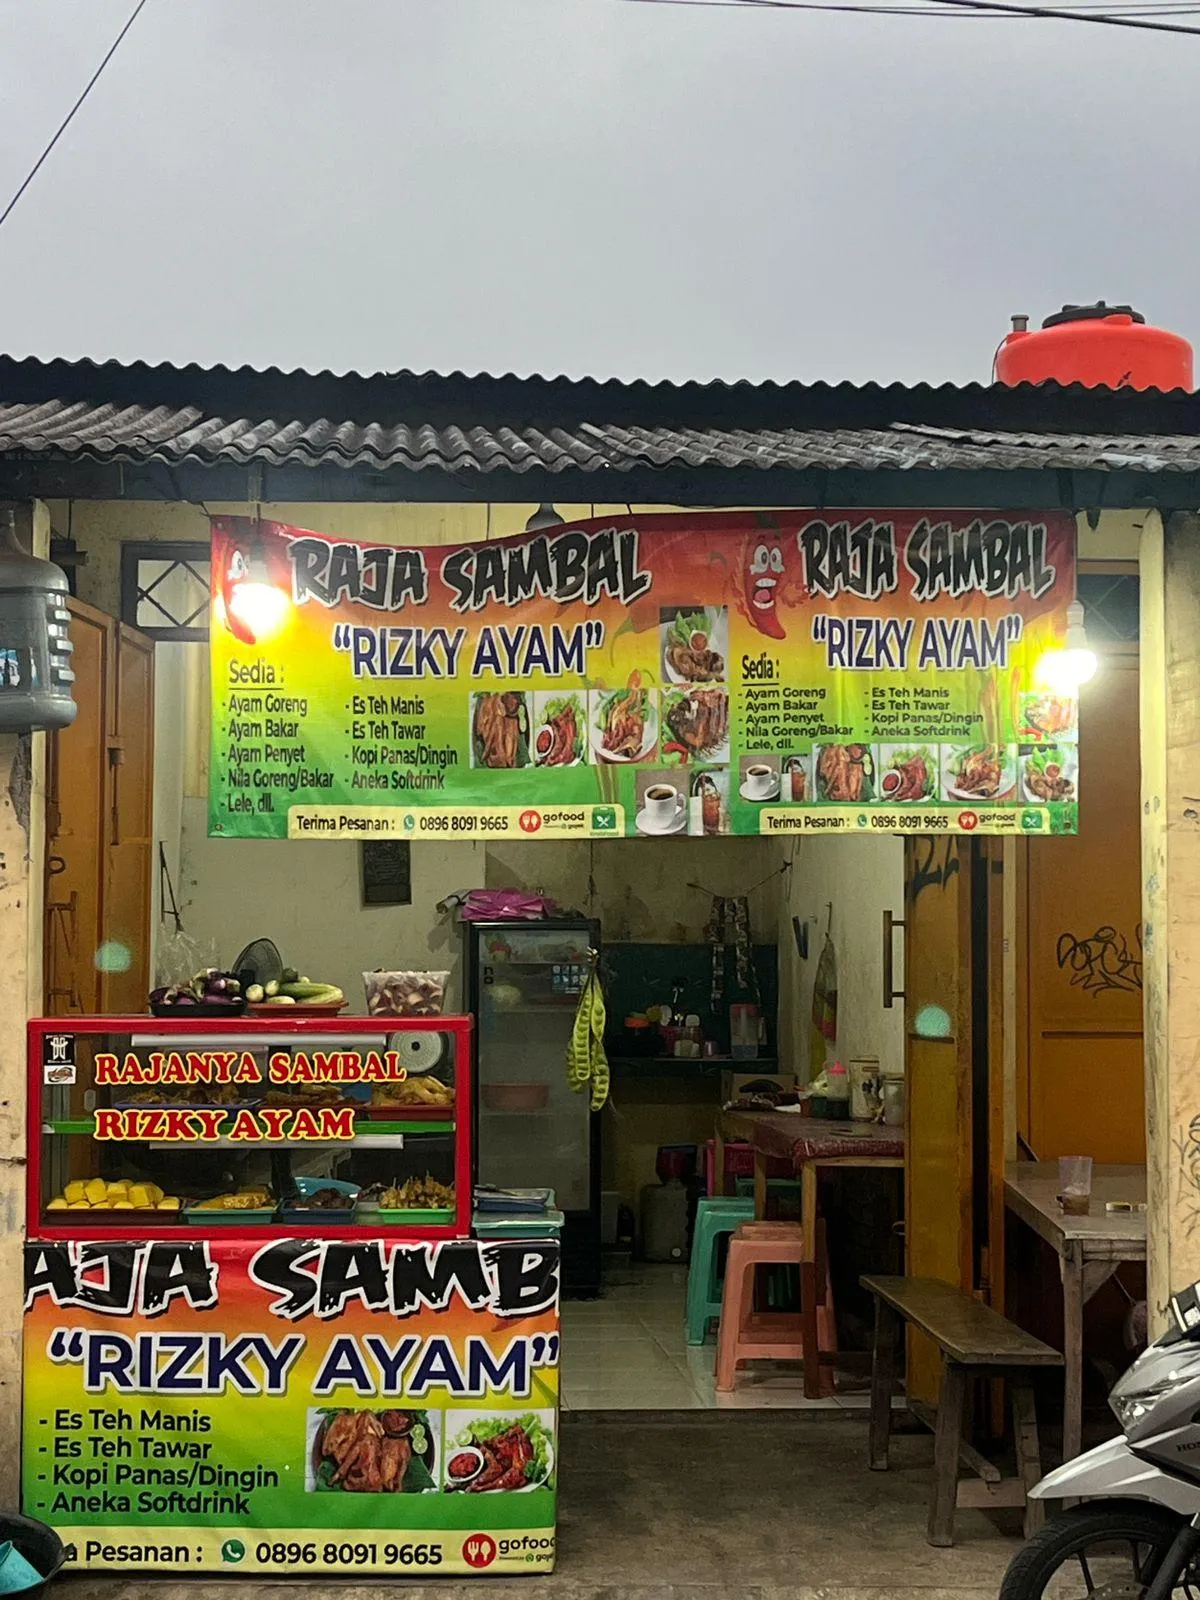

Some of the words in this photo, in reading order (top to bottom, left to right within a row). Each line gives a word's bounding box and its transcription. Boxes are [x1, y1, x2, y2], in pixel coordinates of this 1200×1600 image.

[798, 518, 898, 600] RAJA
[904, 518, 1056, 601] SAMBAL
[287, 537, 428, 610] RAJA
[441, 528, 652, 613] SAMBAL
[745, 688, 780, 701] Ayam
[783, 687, 827, 699] Goreng
[872, 687, 886, 698] Es
[888, 687, 910, 698] Teh
[913, 687, 950, 698] Manis
[228, 694, 262, 717] Ayam
[265, 693, 308, 717] Goreng
[353, 695, 366, 715] Es
[367, 694, 388, 715] Teh
[391, 694, 425, 715] Manis
[745, 701, 780, 713] Ayam
[783, 700, 818, 711] Bakar
[872, 700, 886, 711] Es
[888, 700, 910, 711] Teh
[913, 700, 951, 711] Tawar
[745, 714, 780, 726] Ayam
[783, 713, 825, 725] Penyet
[872, 712, 899, 725] Kopi
[902, 711, 984, 725] Panas/Dingin
[228, 719, 262, 742] Ayam
[265, 718, 299, 737] Bakar
[352, 720, 365, 739] Es
[368, 720, 389, 740] Teh
[391, 720, 426, 740] Tawar
[746, 725, 769, 738] Nila
[772, 724, 854, 739] Goreng/Bakar
[871, 725, 910, 736] Aneka
[913, 725, 971, 736] Softdrink
[227, 744, 261, 767] Ayam
[265, 744, 306, 767] Penyet
[746, 739, 774, 751] Lele,
[352, 744, 378, 769] Kopi
[381, 743, 458, 770] Panas/Dingin
[228, 767, 250, 788] Nila
[253, 766, 335, 792] Goreng/Bakar
[351, 769, 388, 789] Aneka
[391, 769, 445, 790] Softdrink
[227, 793, 255, 815] Lele,
[296, 814, 336, 831] Terima
[339, 815, 389, 831] Pesanan
[419, 815, 448, 831] 0896
[451, 815, 477, 831] 8091
[480, 816, 508, 831] 9665
[542, 811, 585, 824] gofood
[767, 814, 801, 828] Terima
[804, 815, 844, 828] Pesanan
[871, 815, 896, 829] 0896
[899, 815, 922, 829] 8091
[924, 815, 948, 829] 9665
[979, 813, 1016, 823] gofood
[94, 1052, 262, 1085] RAJANYA
[269, 1051, 407, 1083] SAMBAL
[93, 1108, 228, 1141] RIZKY
[228, 1108, 356, 1141] AYAM
[54, 1409, 83, 1430] Es
[89, 1408, 133, 1430] Teh
[140, 1409, 211, 1432] Manis
[54, 1436, 82, 1458] Es
[88, 1436, 132, 1458] Teh
[138, 1437, 212, 1459] Tawar
[53, 1462, 109, 1489] Kopi
[115, 1461, 279, 1492] Panas/Dingin
[51, 1491, 131, 1513] Aneka
[137, 1490, 251, 1514] Softdrink
[85, 1541, 190, 1563] Pesanan
[255, 1542, 317, 1564] 0896
[322, 1543, 377, 1565] 8091
[384, 1543, 443, 1566] 9665
